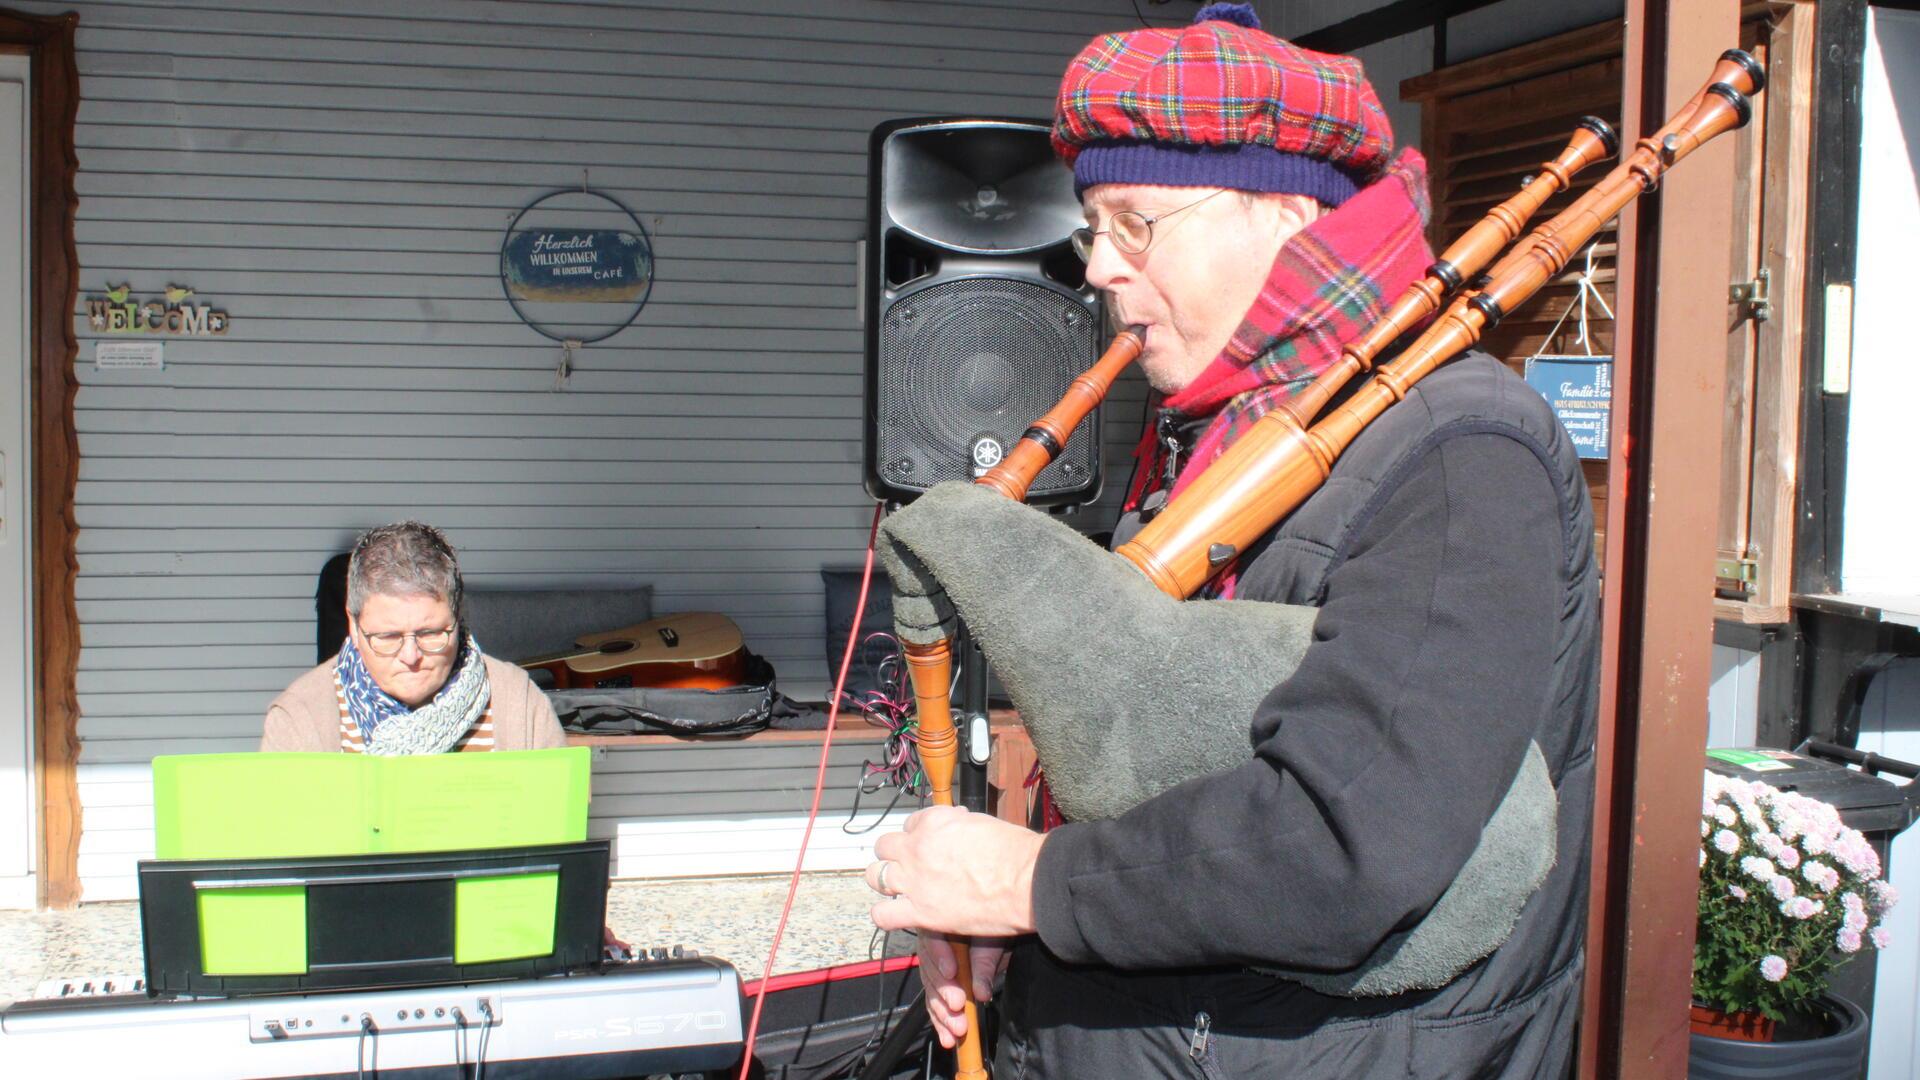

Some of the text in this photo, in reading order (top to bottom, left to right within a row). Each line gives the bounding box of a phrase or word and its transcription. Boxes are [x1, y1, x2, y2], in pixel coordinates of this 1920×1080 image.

[532, 234, 594, 253] Herzlich
[530, 251, 597, 266] WILLKOMMEN
[562, 265, 592, 276] UNSEREM
[594, 266, 623, 279] CAFÉ
[1560, 382, 1594, 398] Familie
[554, 1010, 727, 1041] PSR-S670
